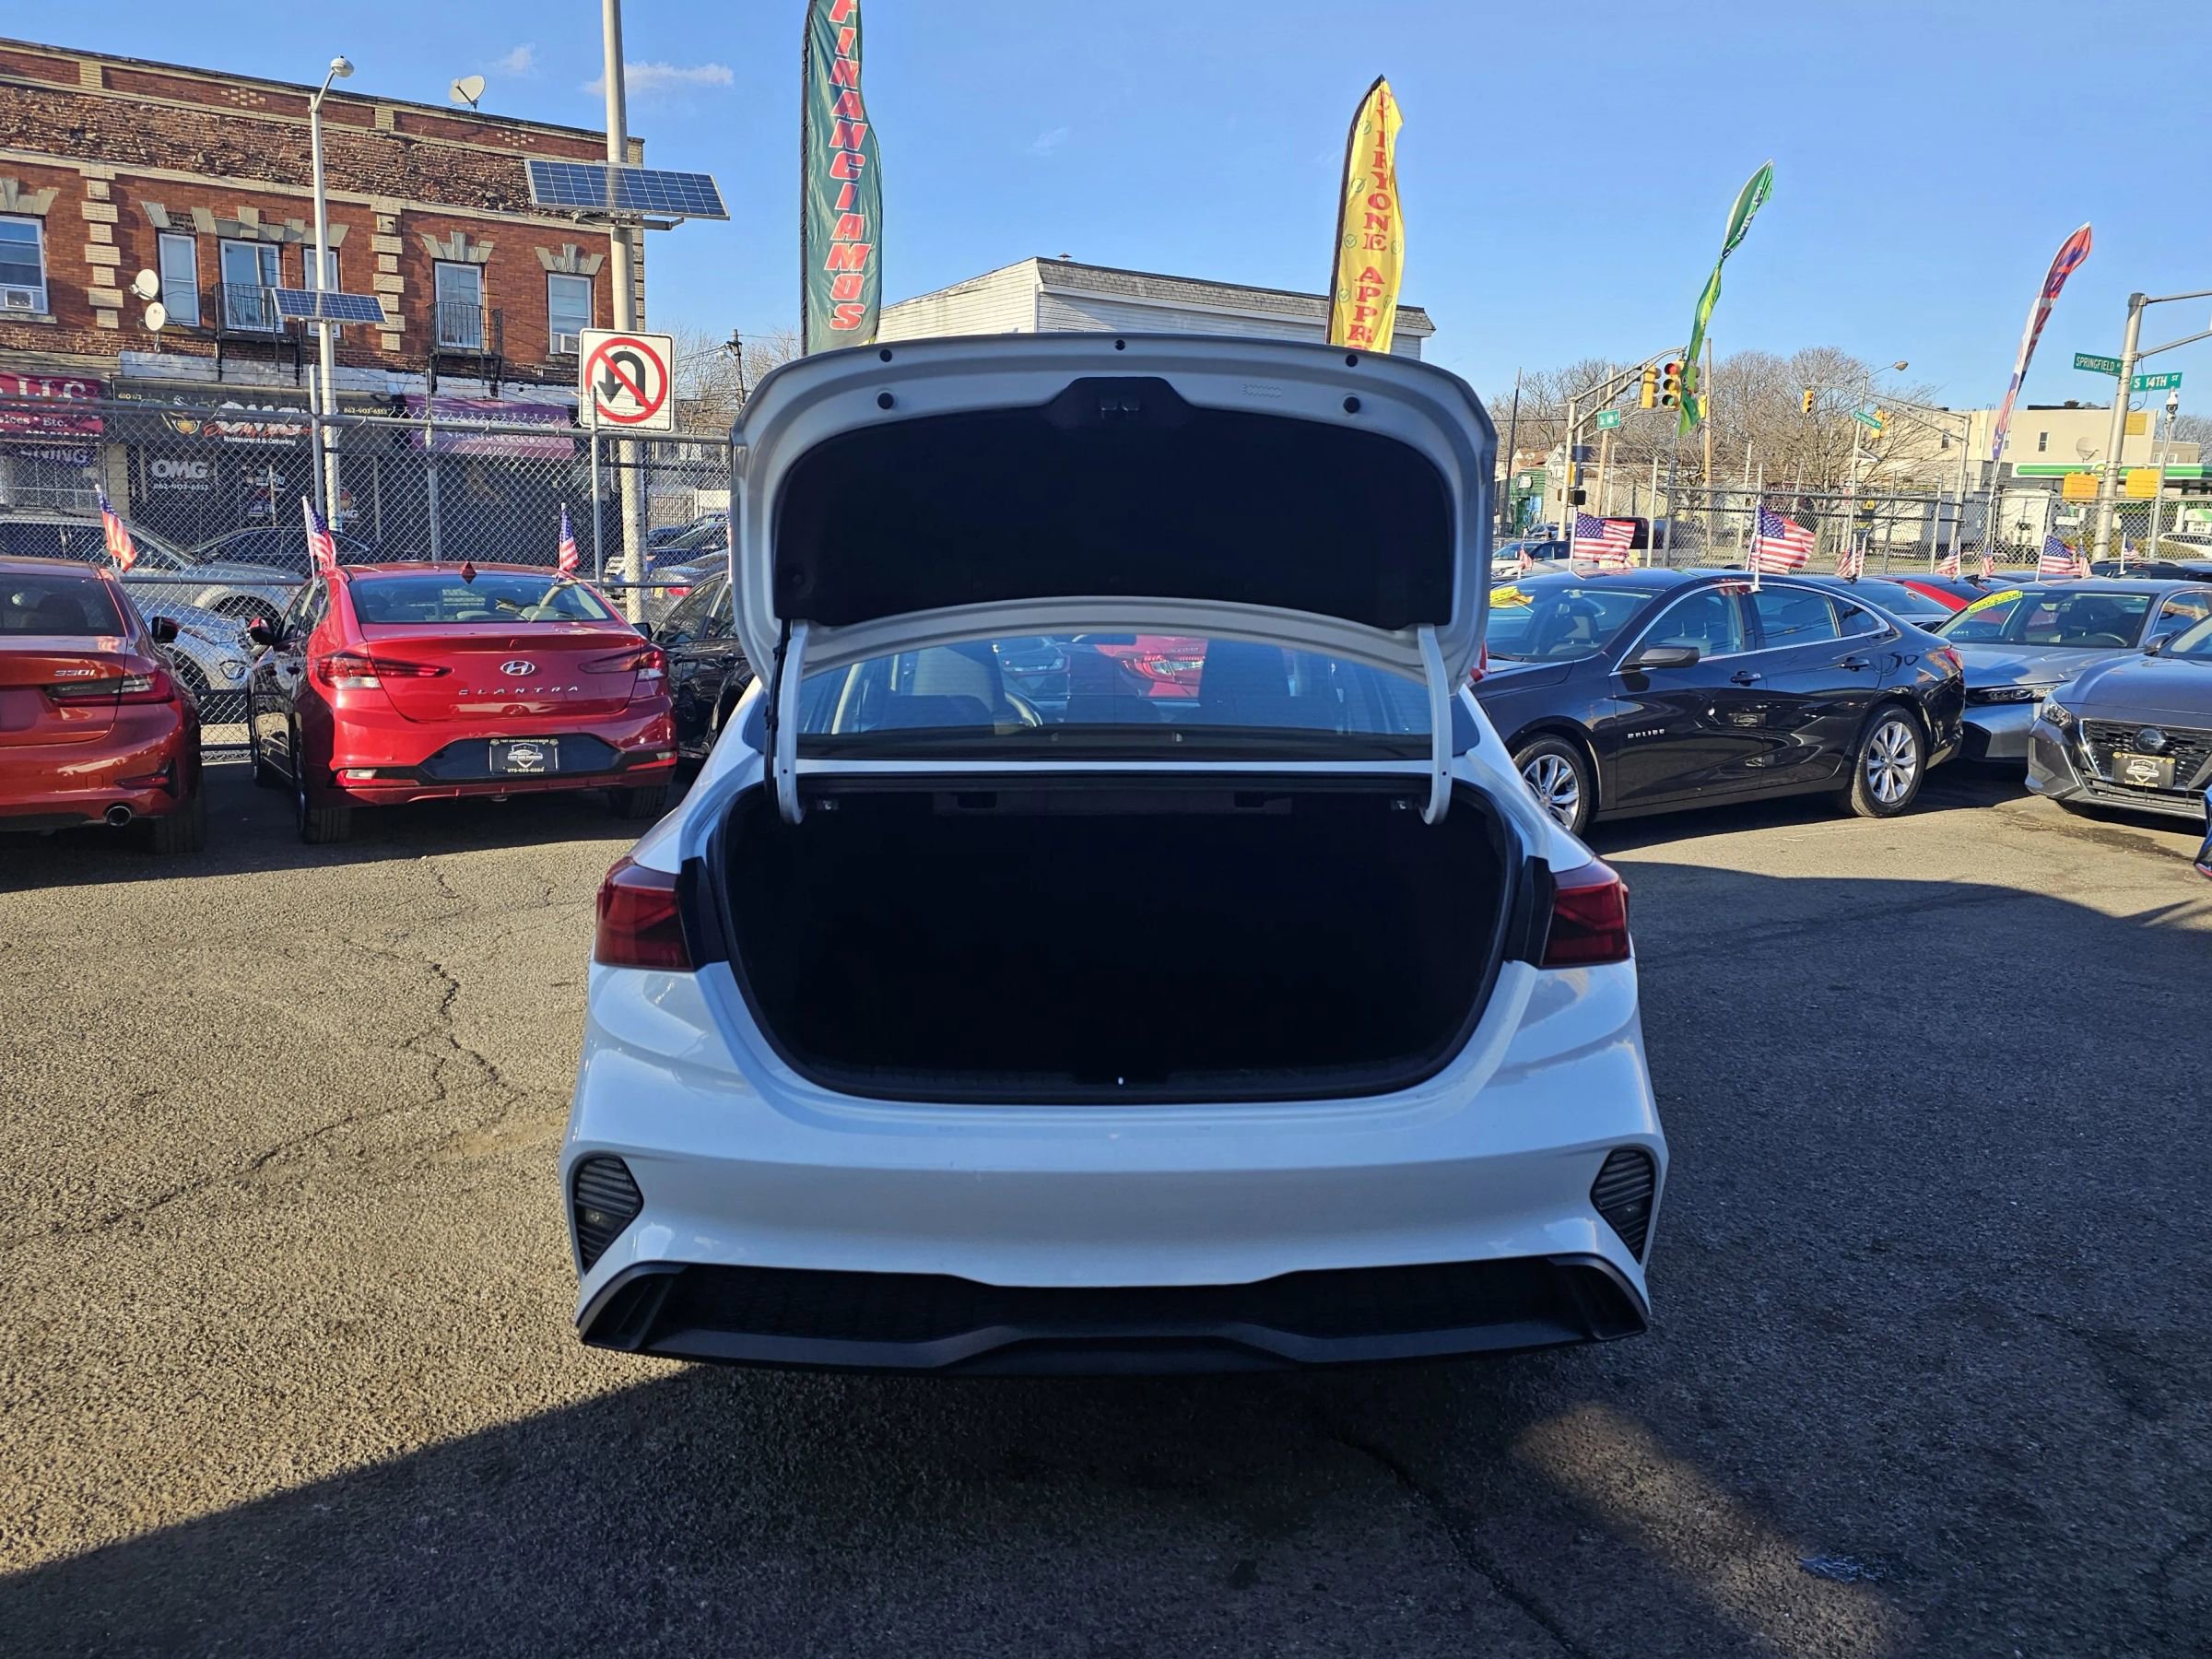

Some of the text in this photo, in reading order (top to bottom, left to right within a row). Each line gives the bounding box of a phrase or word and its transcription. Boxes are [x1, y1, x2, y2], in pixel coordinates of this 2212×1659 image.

[825, 0, 870, 330] FINANCIAMOS
[1347, 265, 1385, 351] APPR
[2076, 357, 2114, 371] SPRINGFIELD
[2134, 378, 2141, 389] S
[2145, 375, 2168, 388] 14TH
[223, 435, 261, 444] Restaurant
[268, 438, 296, 446] Catering
[151, 459, 208, 479] OMG
[459, 687, 578, 695] ELANTRA
[1628, 728, 1665, 739] MALIBU
